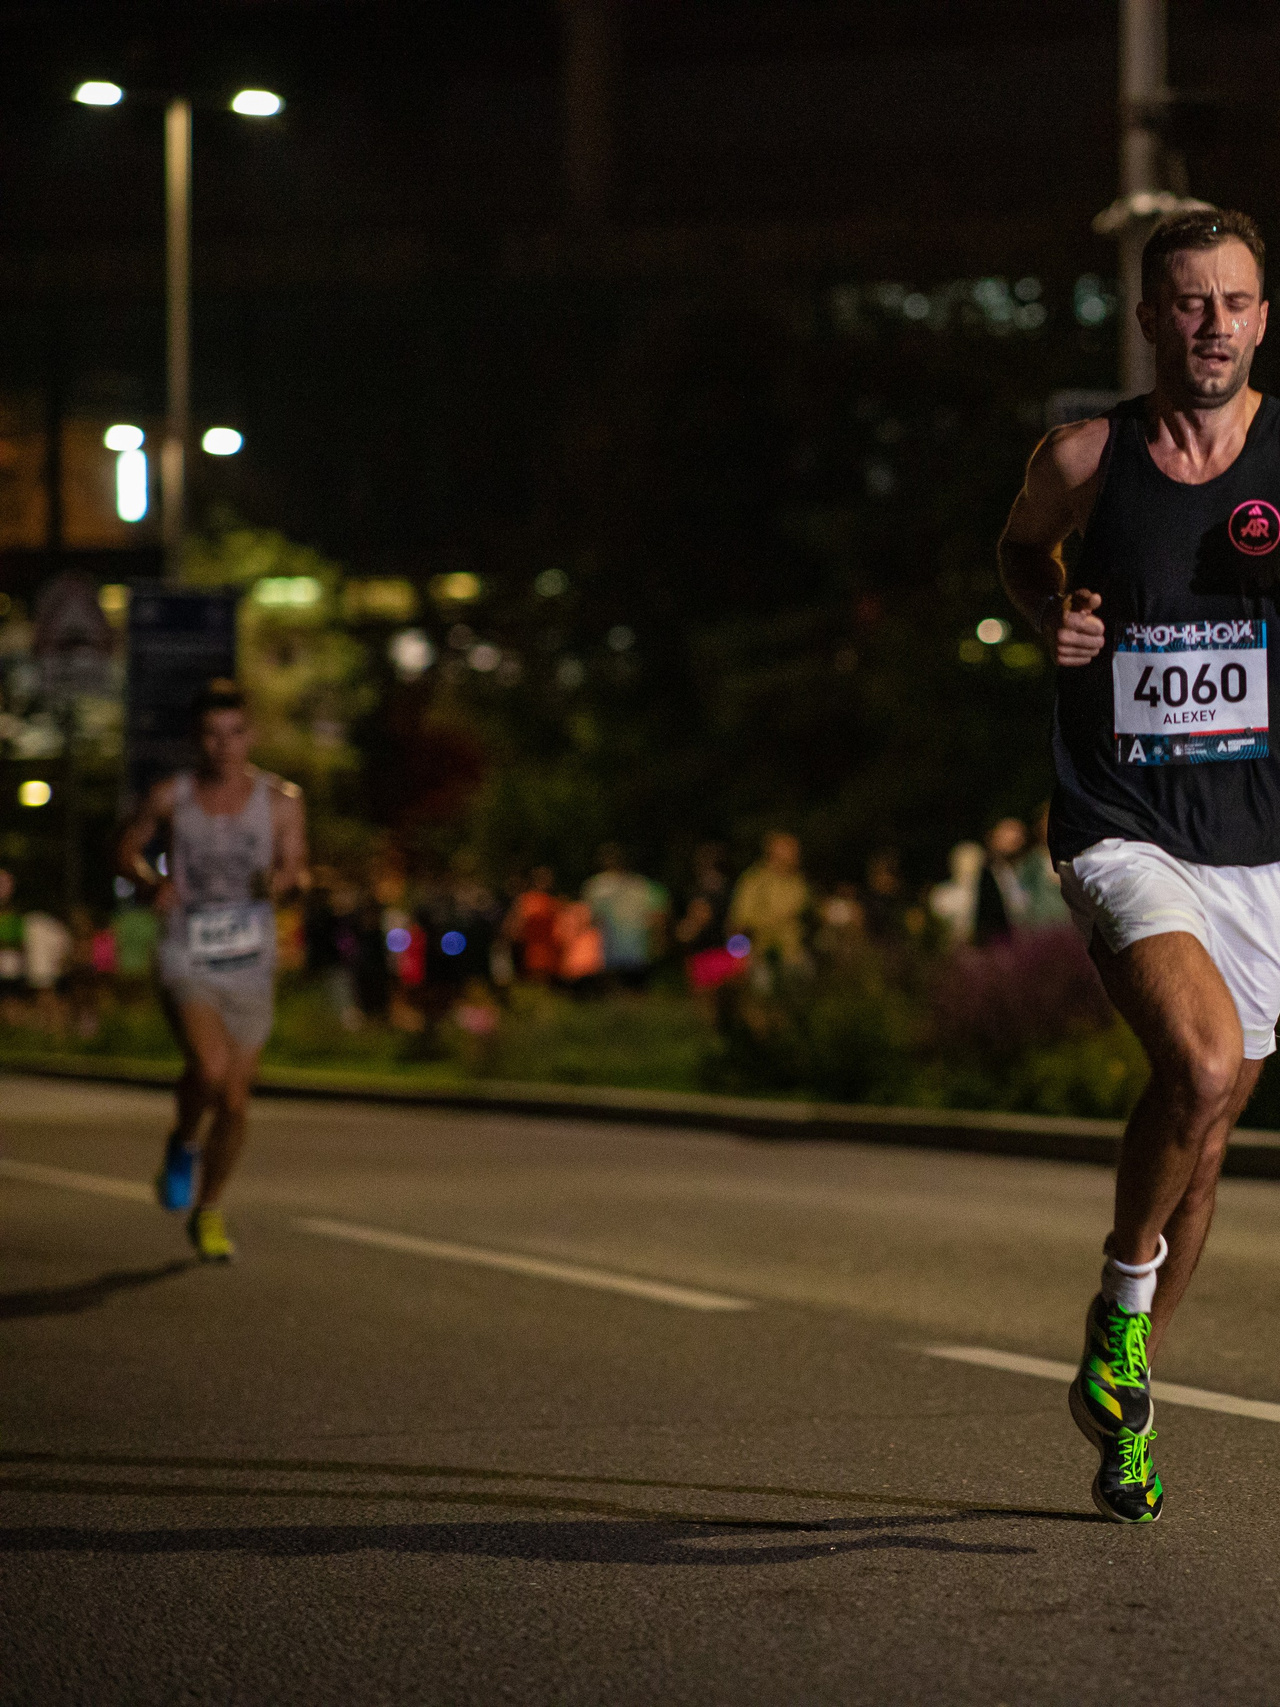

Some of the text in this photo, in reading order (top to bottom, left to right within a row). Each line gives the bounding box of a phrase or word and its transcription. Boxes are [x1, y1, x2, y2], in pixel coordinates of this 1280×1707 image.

[1133, 662, 1247, 708] 4060
[1163, 709, 1217, 725] ALEXEY
[1127, 738, 1147, 763] A
